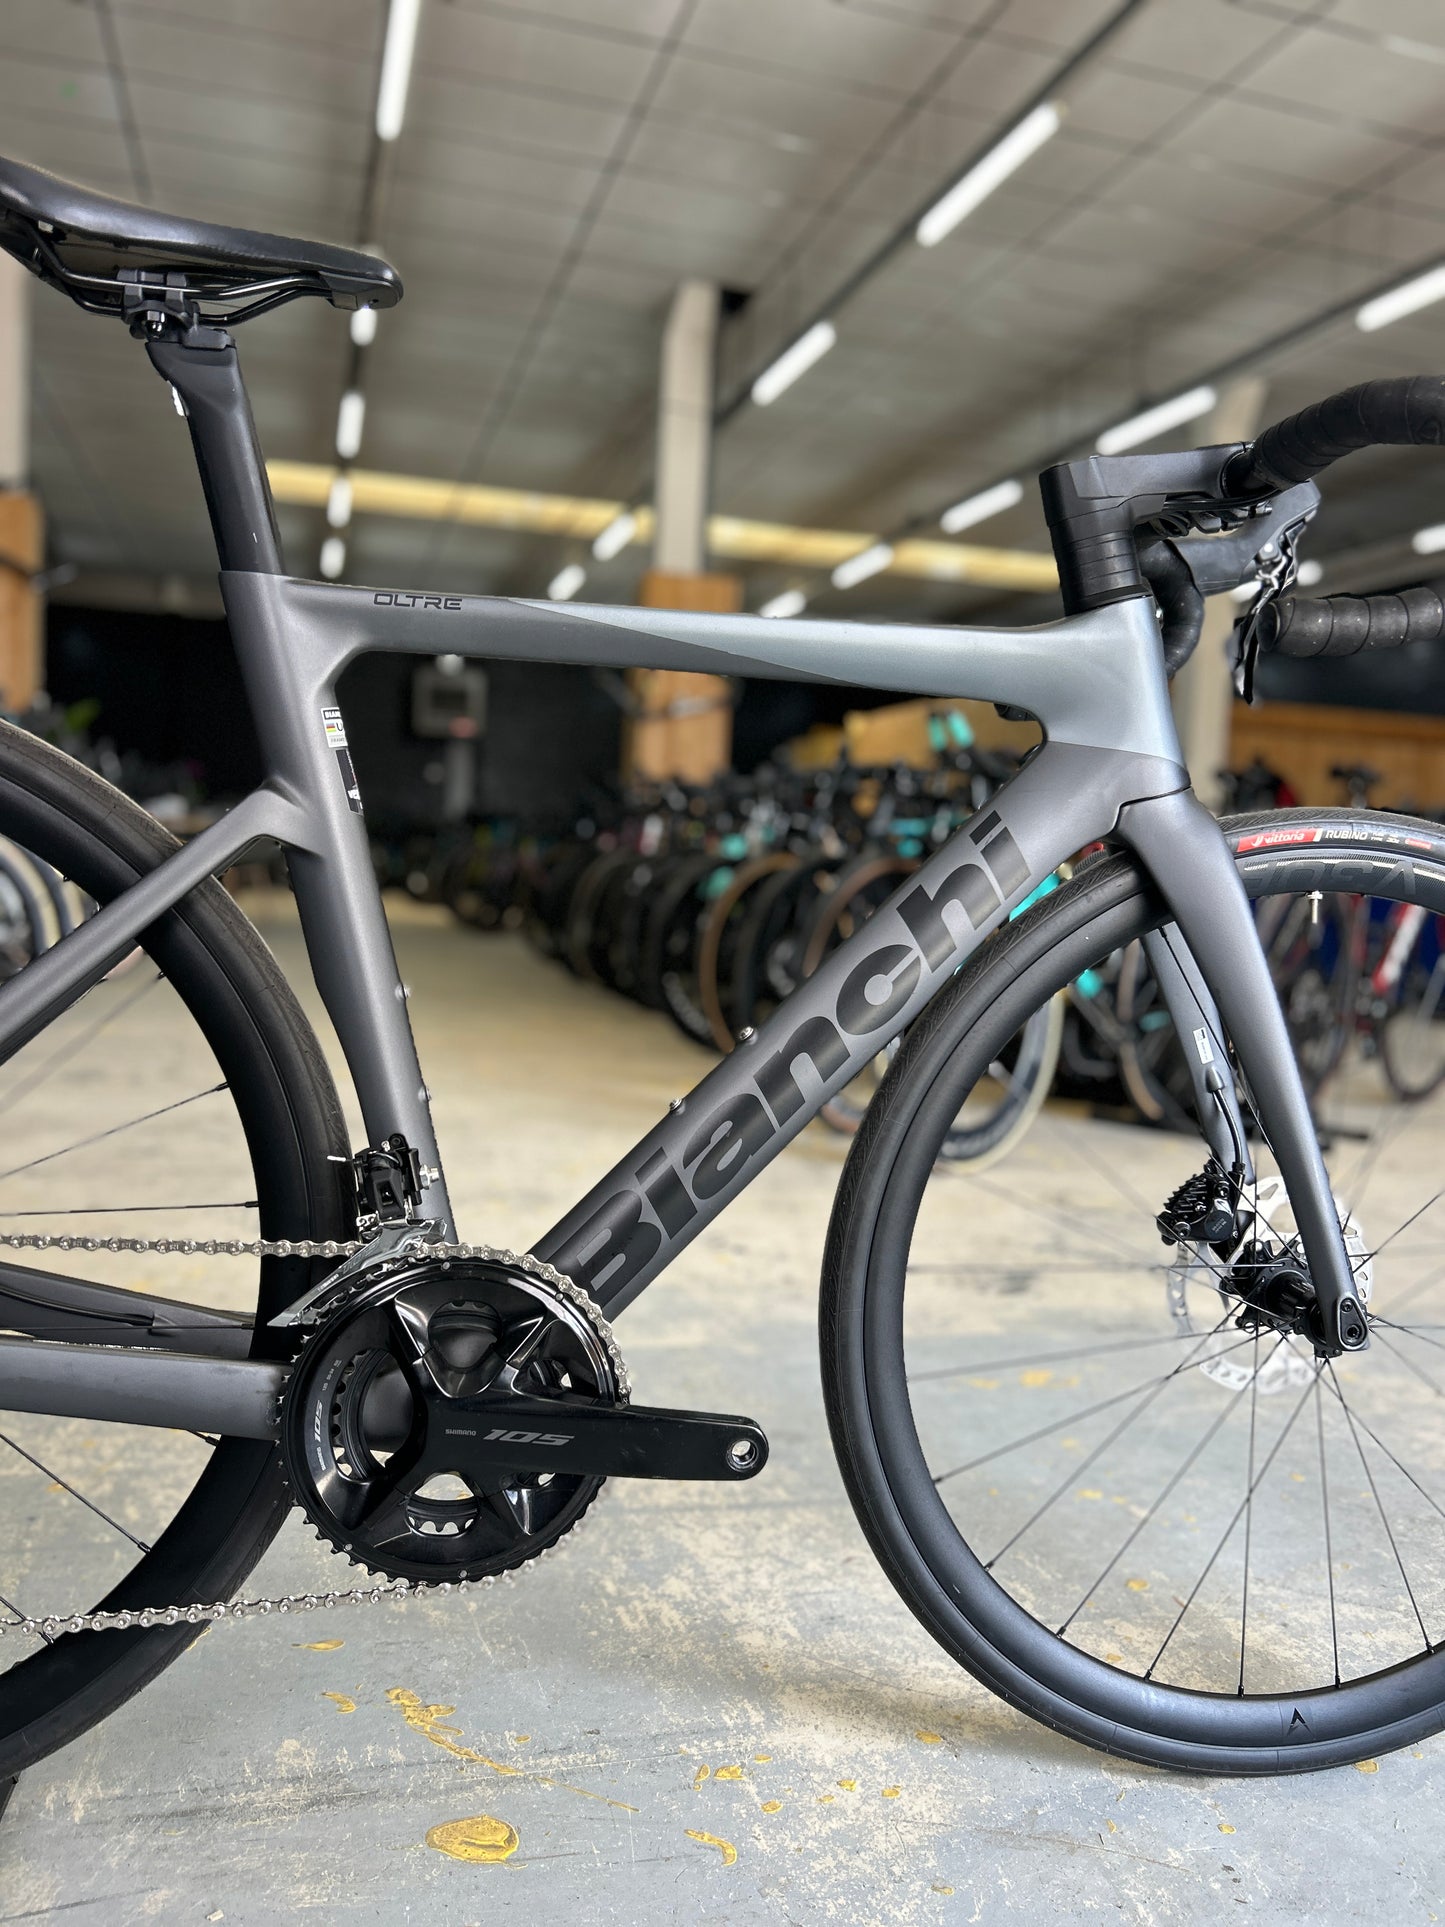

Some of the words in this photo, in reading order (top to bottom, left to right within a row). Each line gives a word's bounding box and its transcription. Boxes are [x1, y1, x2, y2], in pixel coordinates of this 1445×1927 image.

[373, 593, 463, 611] OLTRE
[1264, 831, 1305, 844] vittoria
[1325, 829, 1368, 841] RUBINO
[546, 810, 1032, 1309] Bianchi
[314, 1399, 323, 1442] 105
[445, 1428, 477, 1437] SHIMANO
[483, 1428, 575, 1446] 105
